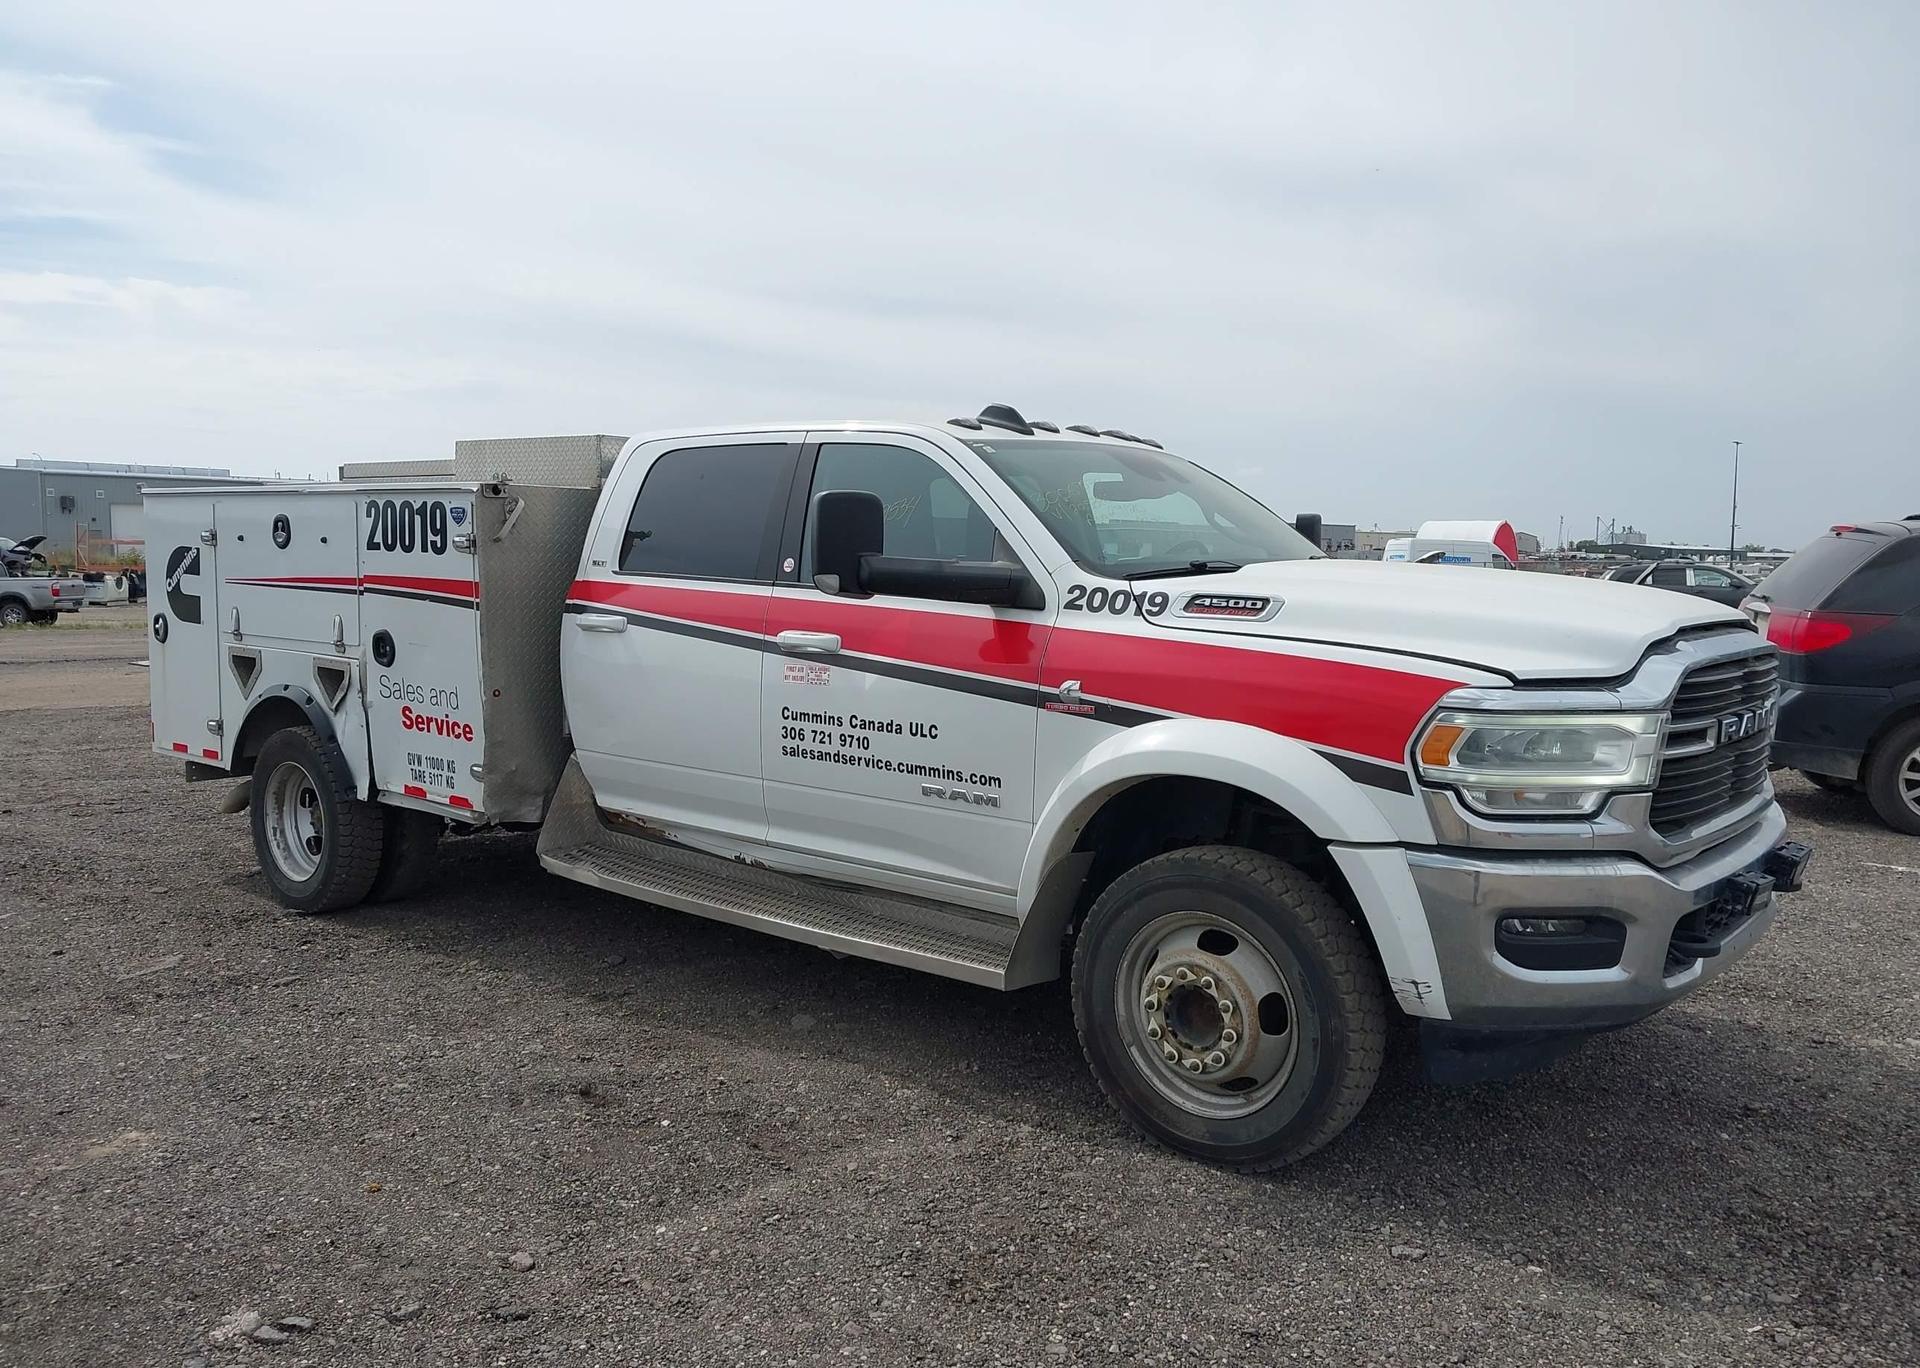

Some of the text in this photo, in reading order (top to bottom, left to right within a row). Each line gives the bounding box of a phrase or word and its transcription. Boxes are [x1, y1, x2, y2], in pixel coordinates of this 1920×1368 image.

[366, 499, 448, 556] 20019
[166, 547, 198, 592] Cummins
[1063, 584, 1170, 617] 20019
[1194, 598, 1263, 609] 4500
[379, 674, 460, 710] Sales and
[401, 705, 474, 742] Service
[781, 706, 939, 740] Cummins Canada ULC
[781, 725, 870, 751] 306 721 9710
[1721, 706, 1769, 743] RAM
[407, 752, 456, 774] GVW 11000 KG
[410, 768, 455, 790] TARE 5117 KG
[781, 744, 1002, 789] salesandservice.cummins.com
[921, 783, 1001, 808] RAM
